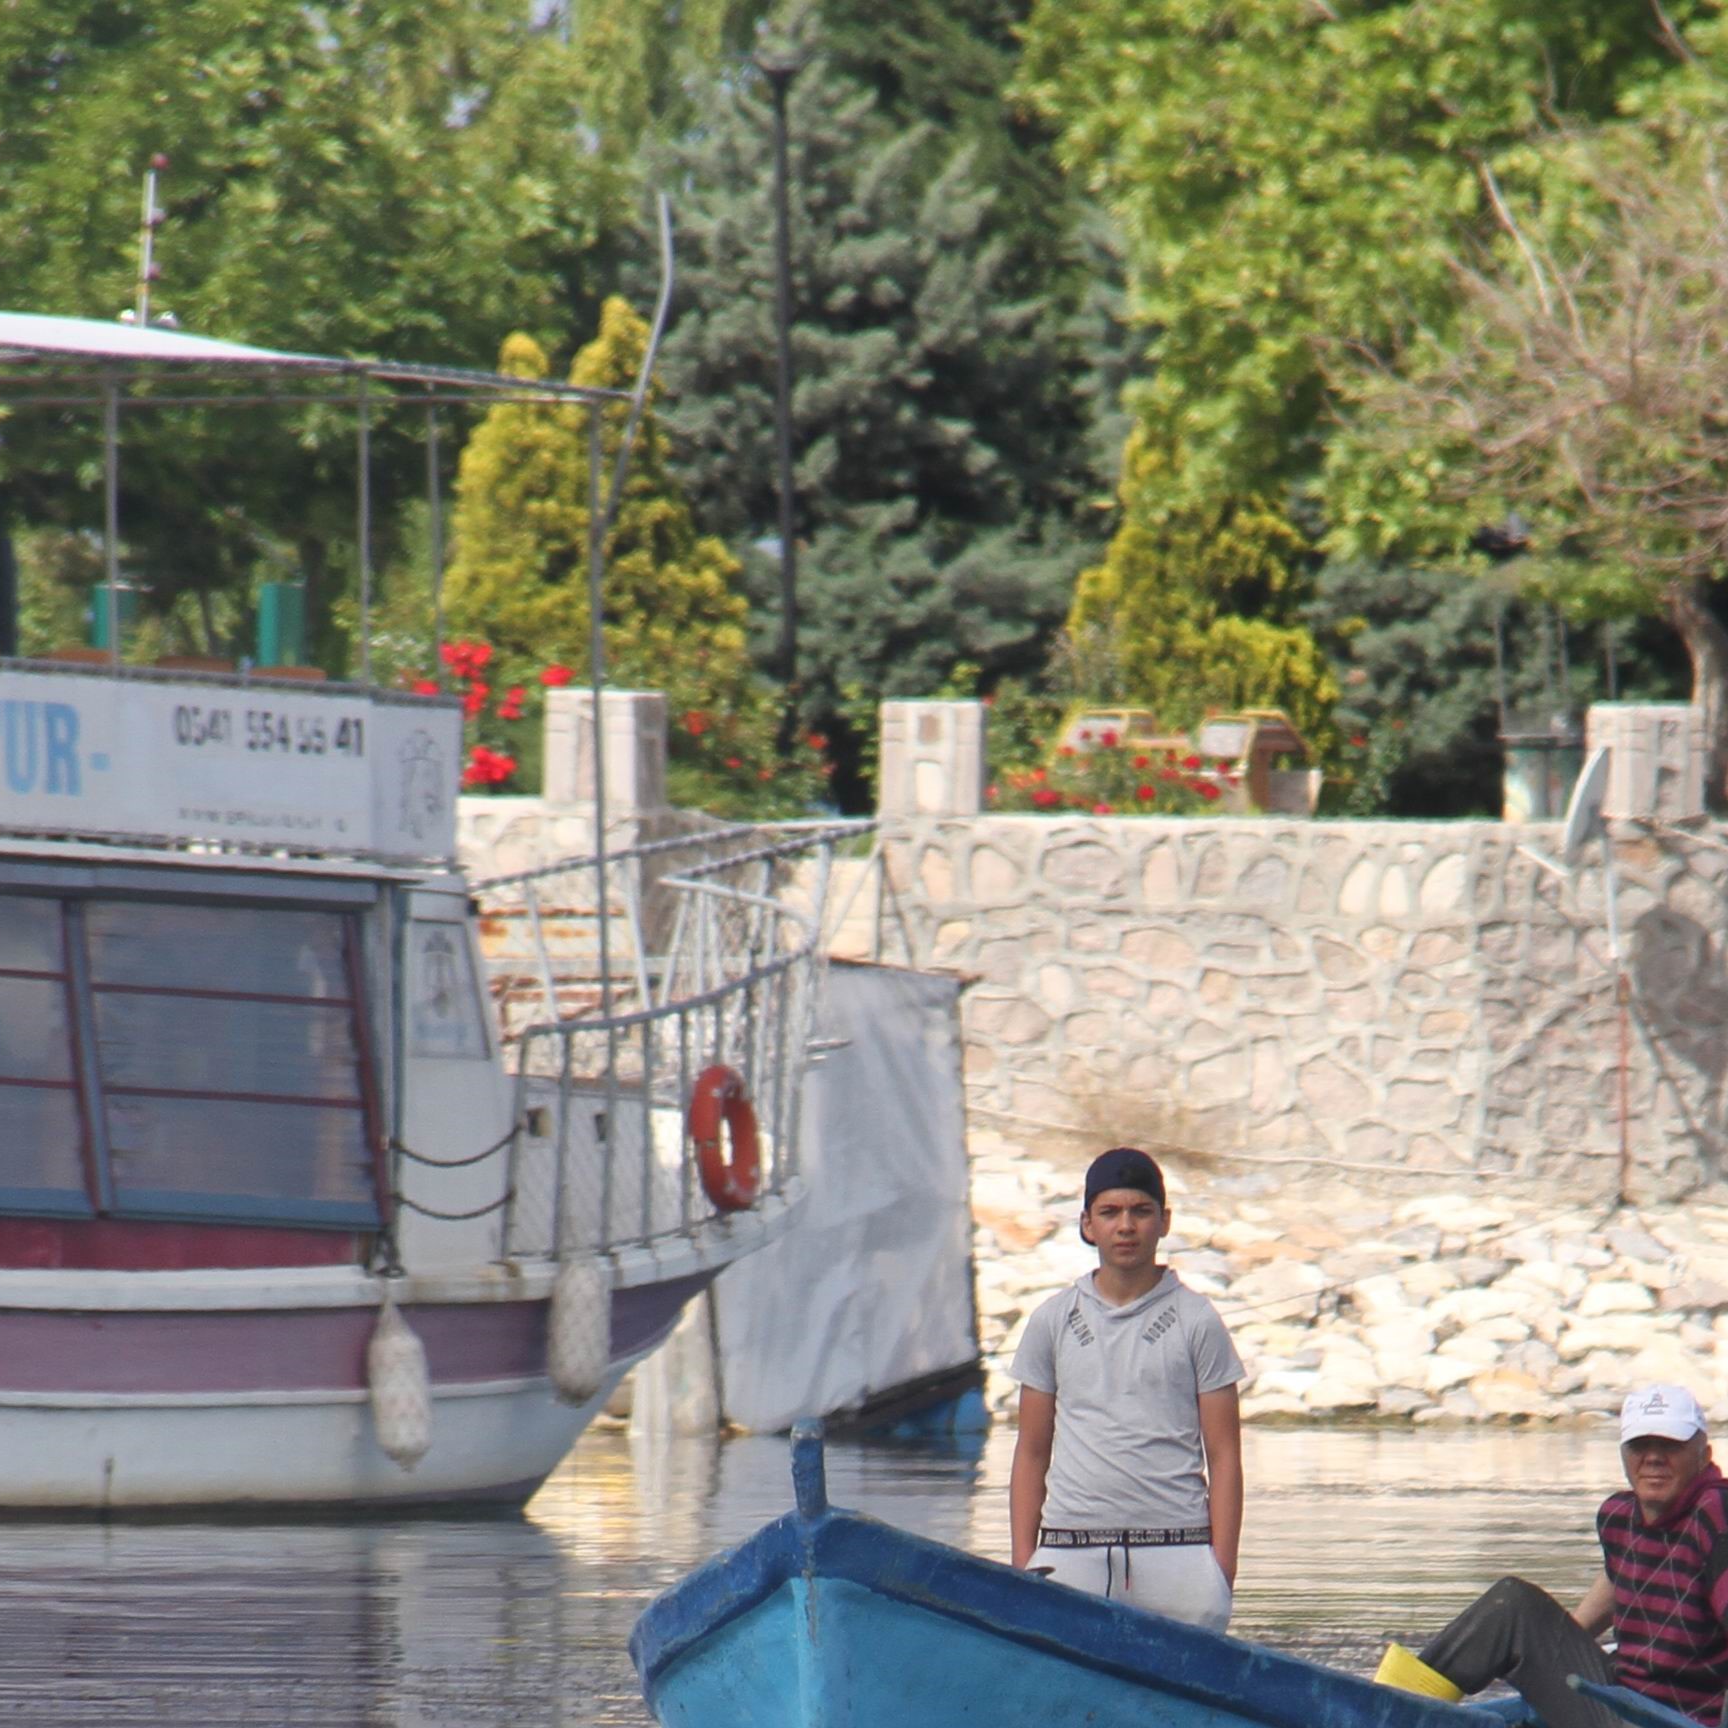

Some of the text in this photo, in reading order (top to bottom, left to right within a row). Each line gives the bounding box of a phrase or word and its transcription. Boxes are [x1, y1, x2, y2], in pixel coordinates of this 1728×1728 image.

[336, 717, 364, 757] 41
[1068, 1308, 1095, 1348] BELONG
[1141, 1304, 1177, 1346] NOBODY
[1075, 1530, 1087, 1544] TO
[1129, 1529, 1166, 1543] BELONG
[1169, 1529, 1182, 1543] TO
